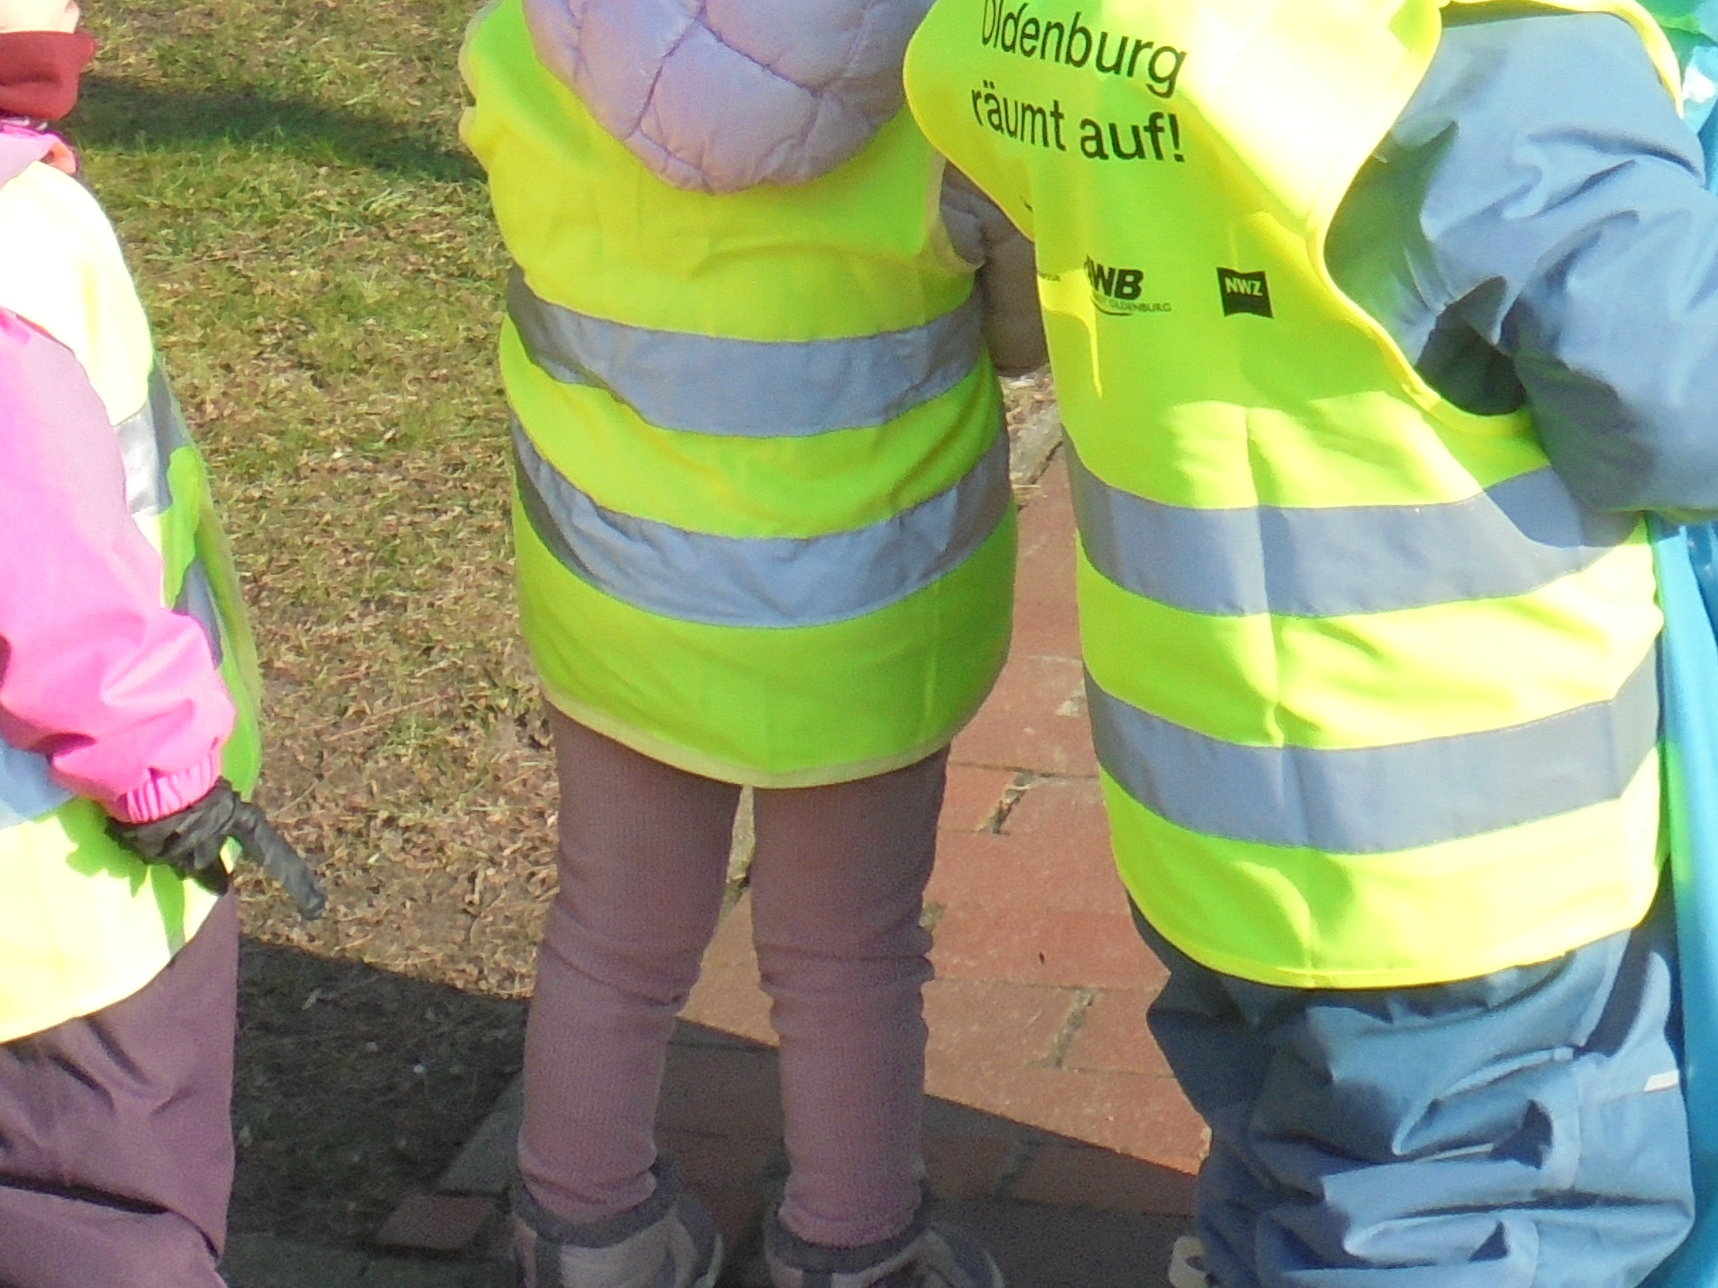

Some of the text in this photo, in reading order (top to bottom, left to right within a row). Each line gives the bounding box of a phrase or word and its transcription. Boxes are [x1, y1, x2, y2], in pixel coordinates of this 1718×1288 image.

[971, 80, 1187, 162] räumt auf!
[1224, 277, 1264, 297] NWZ
